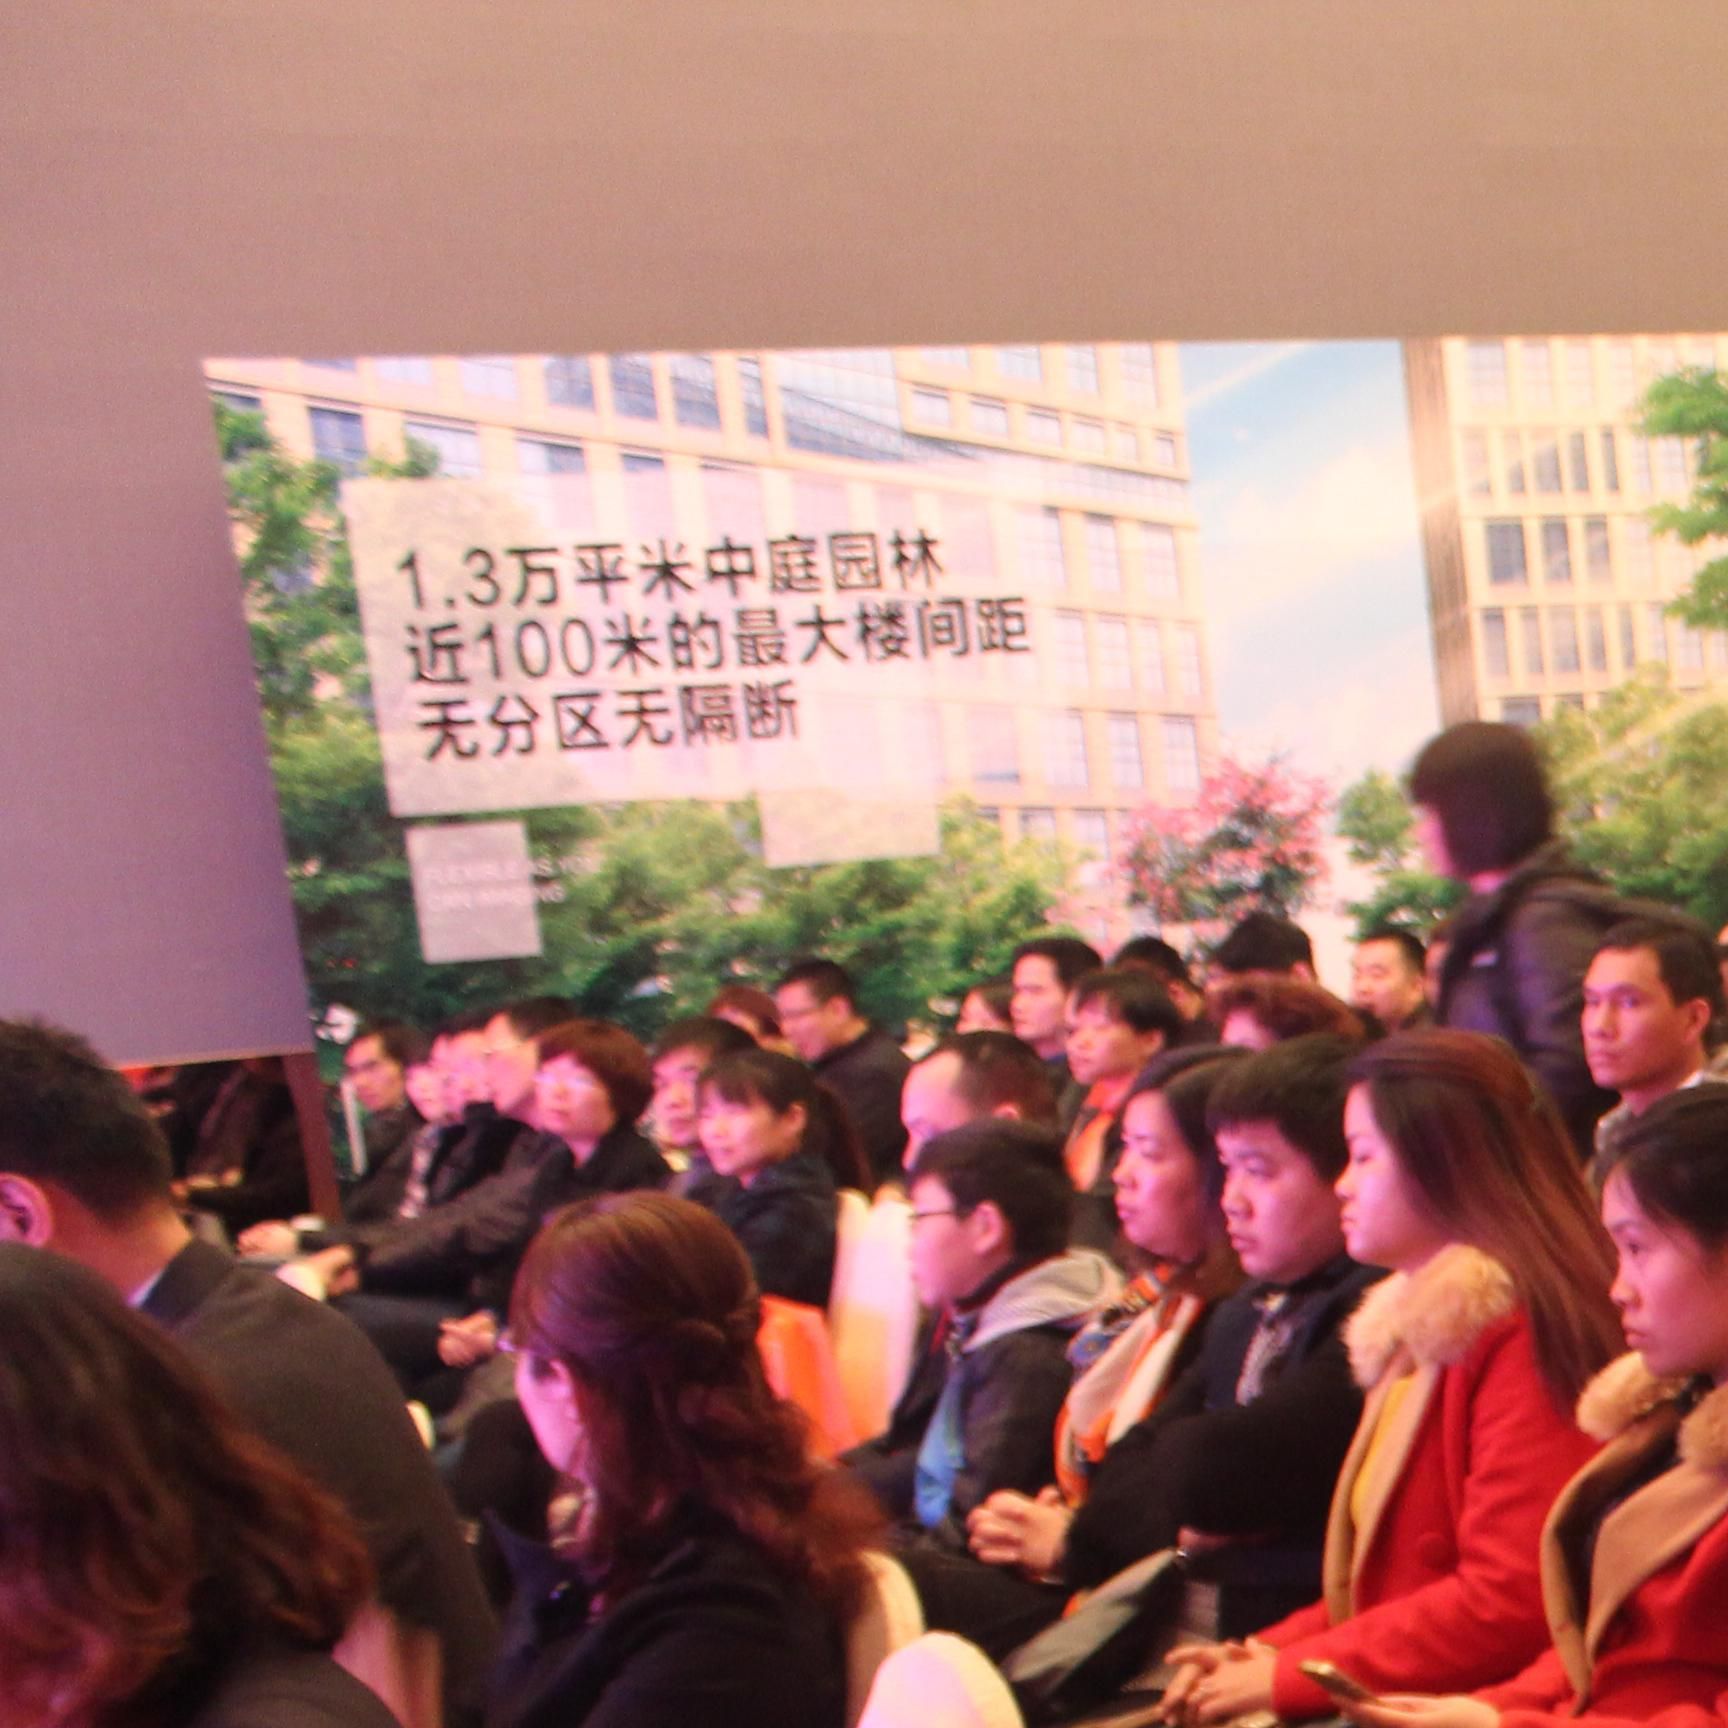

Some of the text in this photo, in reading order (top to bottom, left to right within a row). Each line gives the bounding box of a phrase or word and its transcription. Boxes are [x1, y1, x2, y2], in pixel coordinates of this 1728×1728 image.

[396, 528, 944, 611] 1.3万平米中庭园林
[404, 597, 1034, 686] 近100米的最大楼间距
[418, 680, 800, 763] 无分区无隔断
